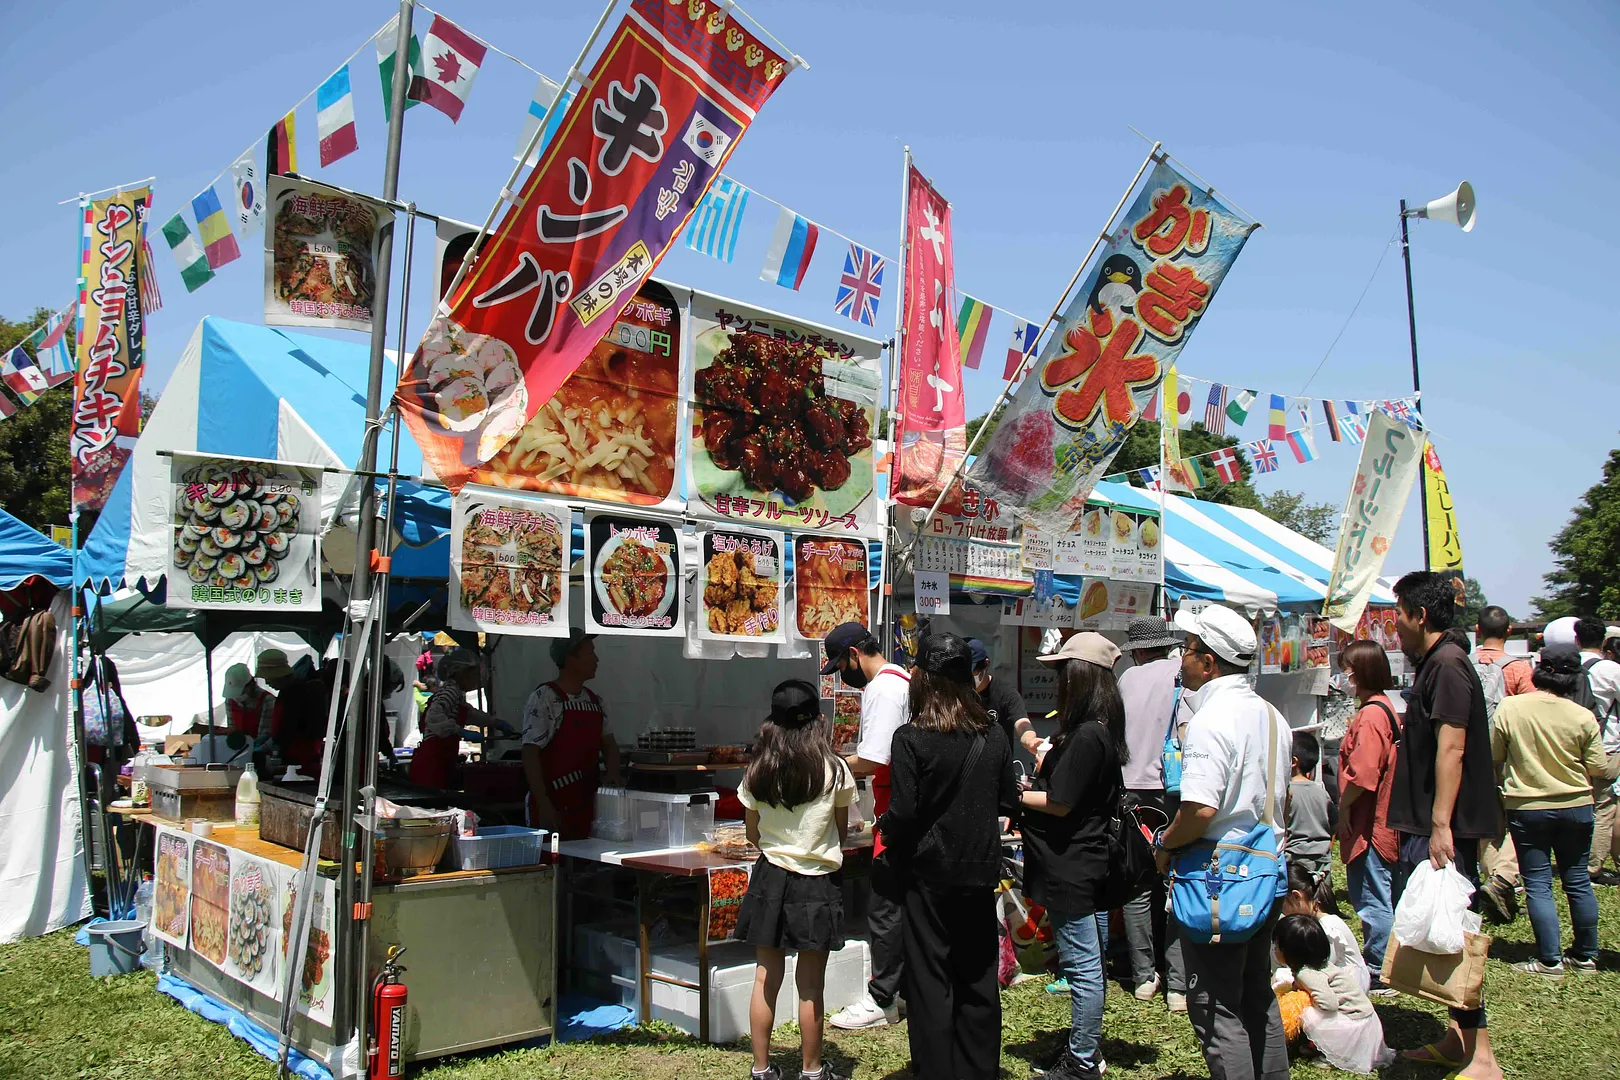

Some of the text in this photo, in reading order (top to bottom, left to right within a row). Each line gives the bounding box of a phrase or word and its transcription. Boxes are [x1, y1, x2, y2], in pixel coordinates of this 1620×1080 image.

[656, 160, 695, 220] 김밥
[473, 73, 669, 345] キンパ
[580, 252, 644, 317] 本場の味
[1038, 183, 1214, 433] かき氷
[715, 309, 856, 360] ヤンニョンチキン
[714, 492, 860, 531] 甘辛フルーツソース
[961, 487, 1000, 522] き氷
[609, 522, 660, 541] トッポギ
[1434, 476, 1462, 568] カレーパン
[712, 534, 774, 556] 塩からあげ
[1057, 540, 1076, 548] ナチョス
[191, 584, 303, 605] 韓国式のりまき
[920, 580, 938, 590] カキ氷
[472, 607, 549, 625] 韓国お好み焼き
[919, 596, 942, 608] 300円
[744, 607, 778, 636] 手作り
[1034, 676, 1059, 684] グルメ
[390, 1007, 402, 1059] YAMATO
